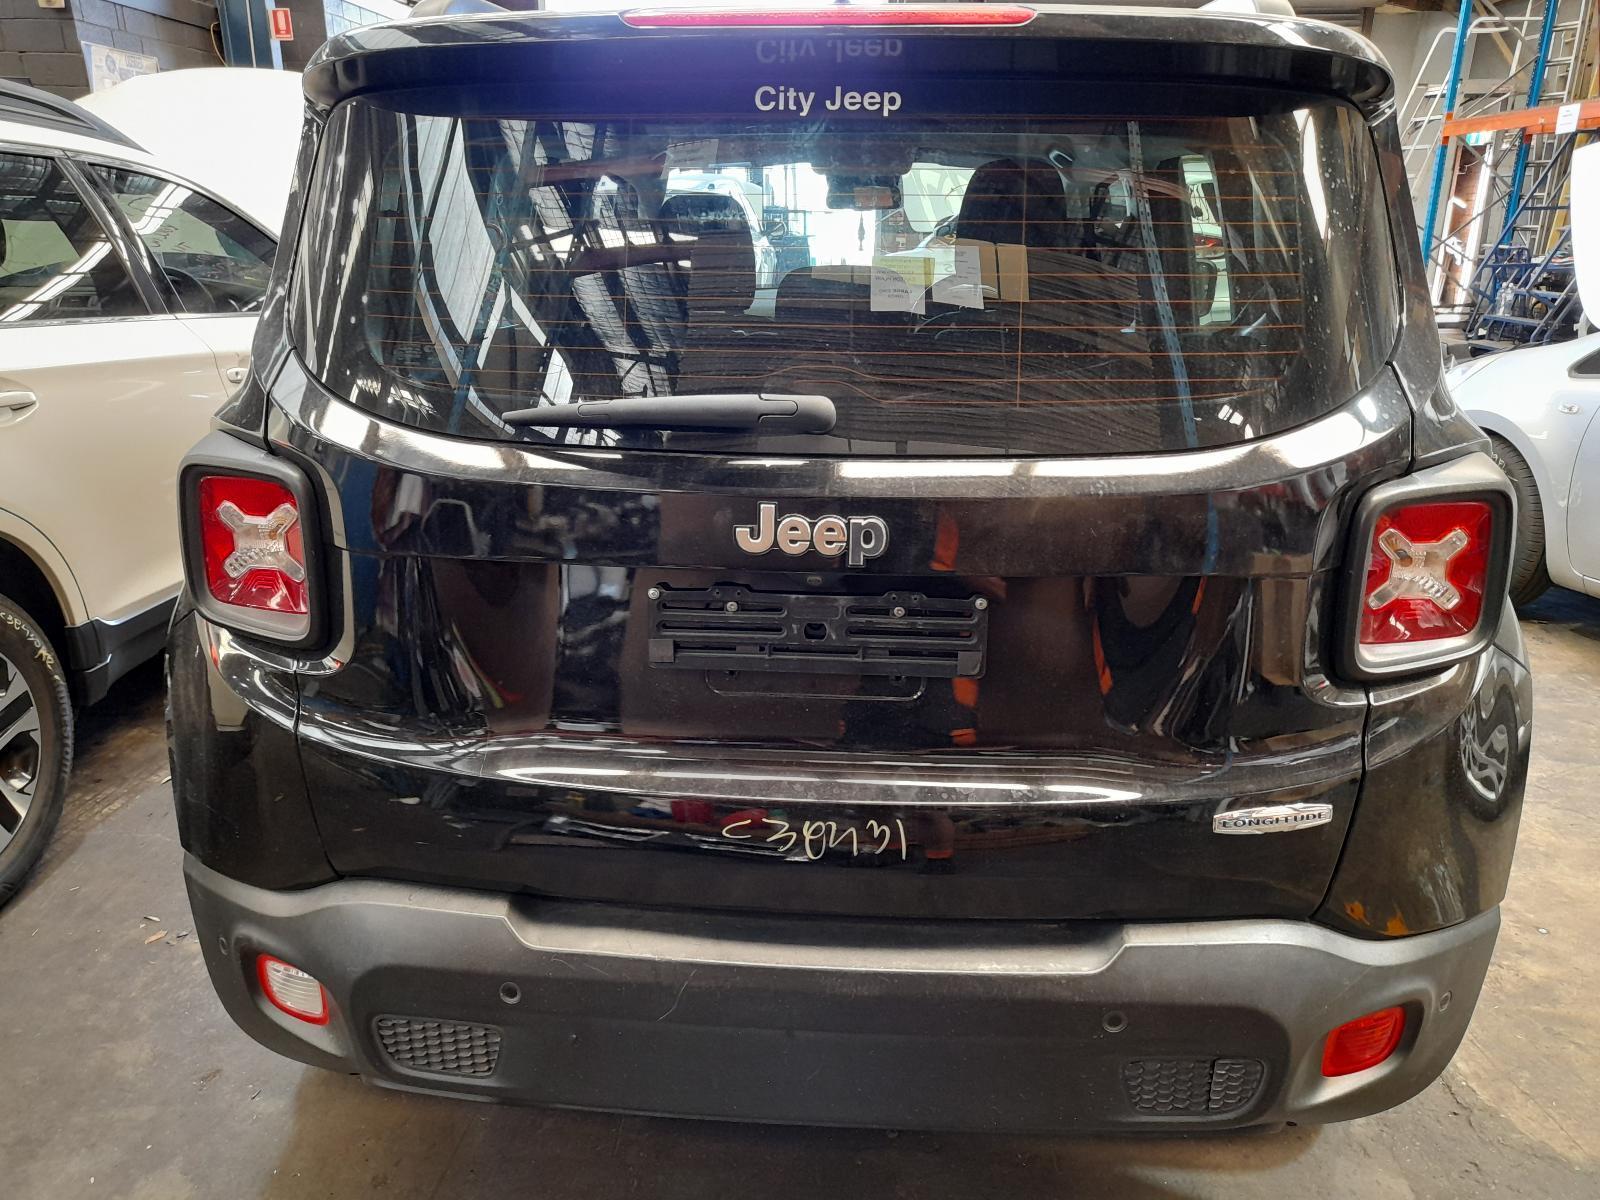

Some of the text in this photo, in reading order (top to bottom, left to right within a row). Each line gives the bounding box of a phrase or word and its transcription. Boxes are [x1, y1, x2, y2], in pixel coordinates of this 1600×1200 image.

[755, 86, 902, 117] City Jeep
[734, 502, 889, 567] Jeep
[1220, 811, 1328, 829] LONGITUDE
